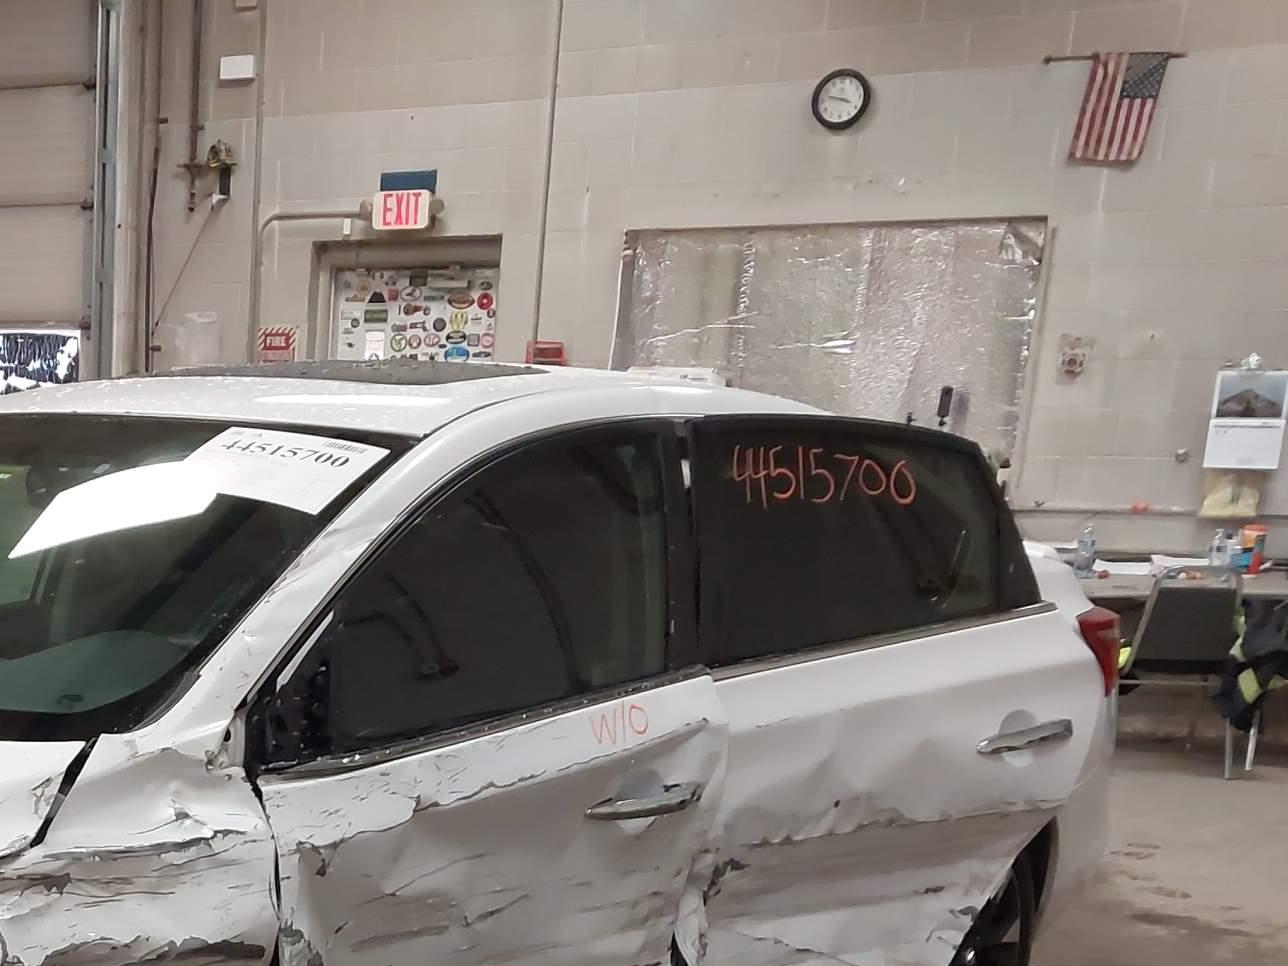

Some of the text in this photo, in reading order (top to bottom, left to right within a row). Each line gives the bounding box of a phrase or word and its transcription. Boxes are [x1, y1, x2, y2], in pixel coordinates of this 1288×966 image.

[382, 191, 422, 227] EXIT
[266, 335, 287, 347] FIRE
[221, 439, 351, 468] 44515700
[732, 444, 917, 510] 44515700
